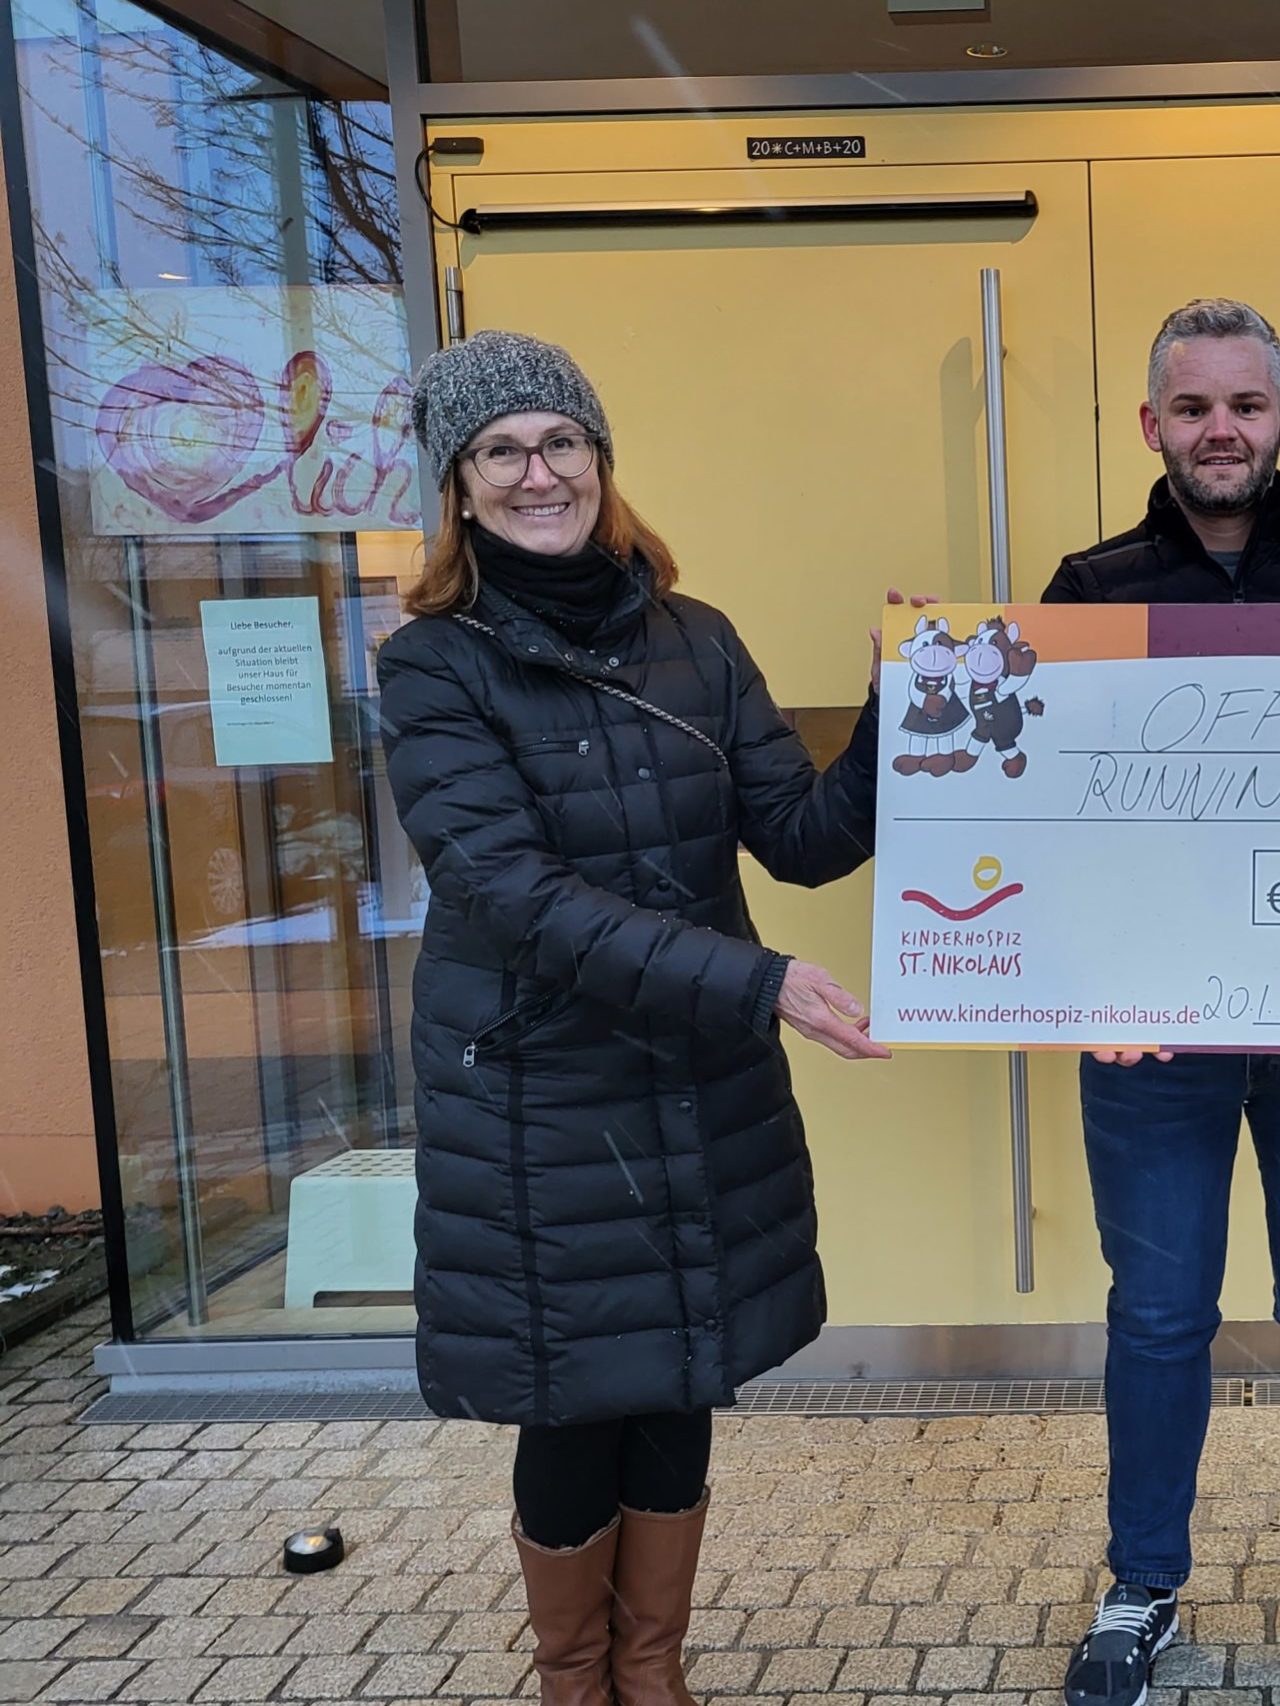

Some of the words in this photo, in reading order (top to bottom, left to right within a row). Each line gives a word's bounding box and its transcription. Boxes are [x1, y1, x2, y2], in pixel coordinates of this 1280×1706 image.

[218, 645, 257, 657] aufgrund
[258, 645, 272, 654] der
[273, 643, 313, 653] aktuellen
[235, 658, 273, 668] Situation
[274, 656, 299, 666] bleibt
[238, 671, 261, 679] unser
[263, 669, 284, 678] Haus
[285, 668, 298, 677] für
[226, 682, 264, 692] Besucher
[265, 681, 312, 690] momentan
[240, 693, 293, 706] geschlossen!
[901, 929, 1022, 948] KINDERHOSPIZ
[931, 952, 1022, 977] NIKOLAUS
[898, 1003, 1200, 1029] www.kinderhospiz-nikolaus.de
